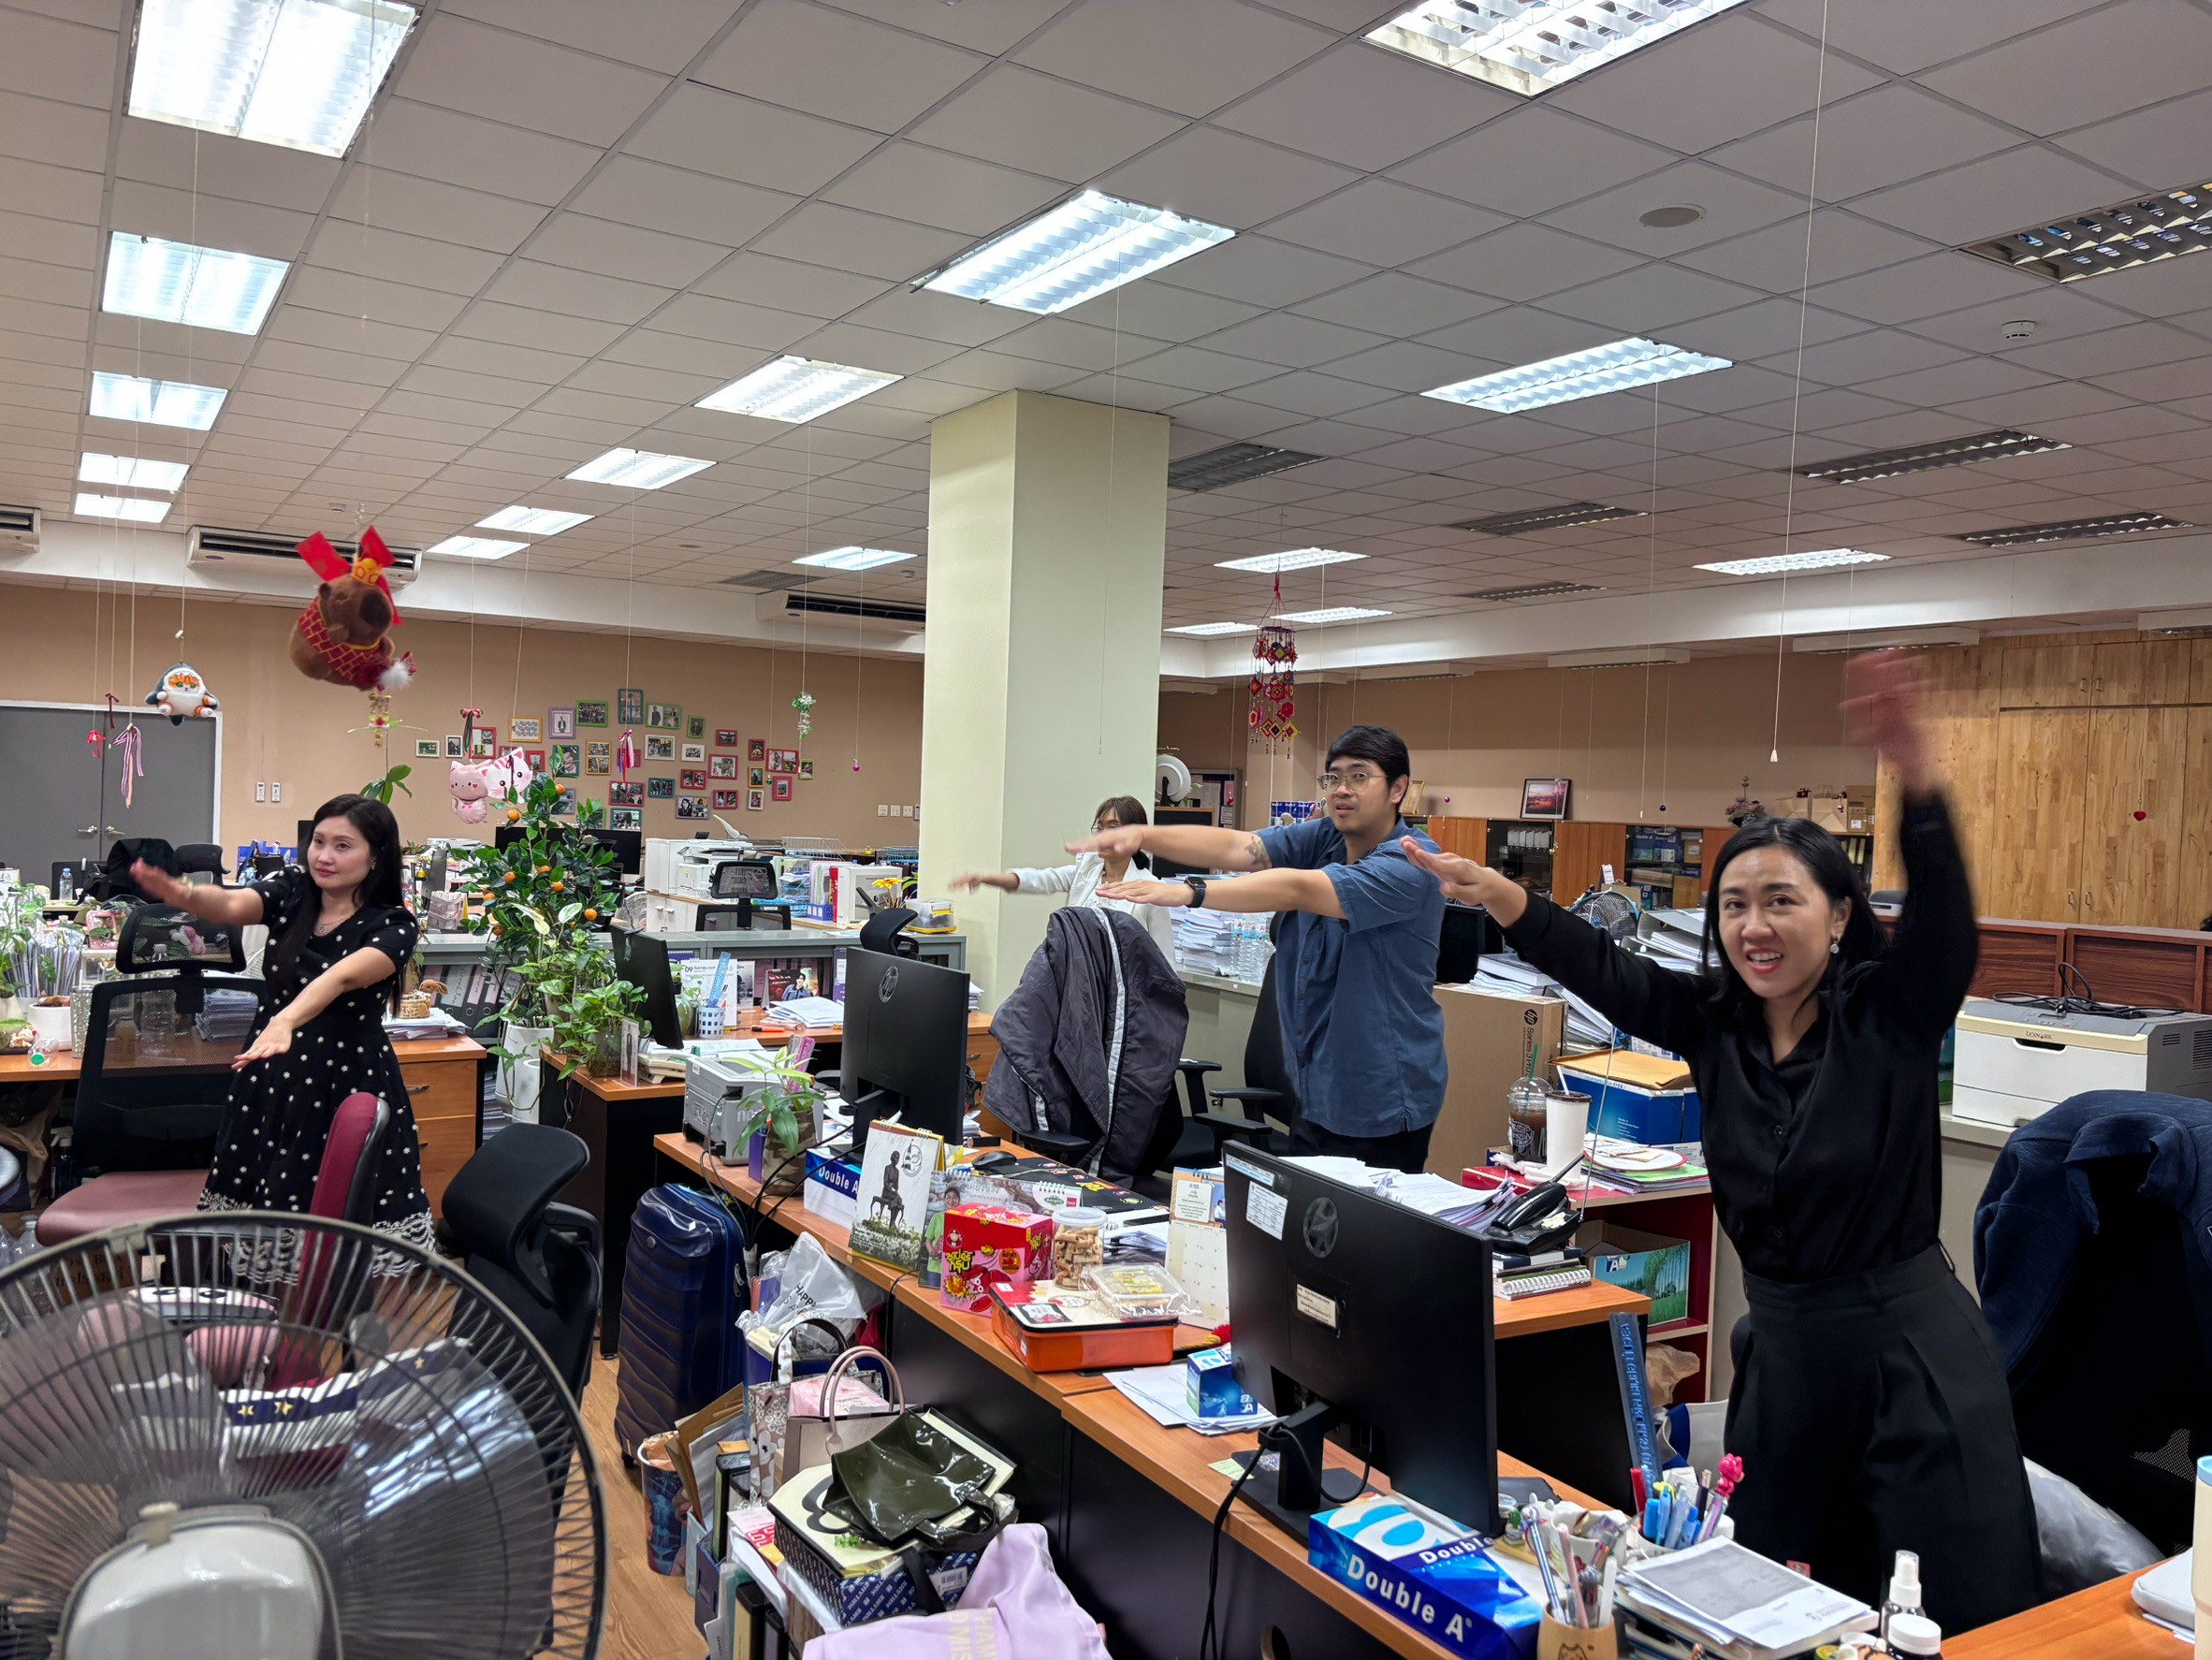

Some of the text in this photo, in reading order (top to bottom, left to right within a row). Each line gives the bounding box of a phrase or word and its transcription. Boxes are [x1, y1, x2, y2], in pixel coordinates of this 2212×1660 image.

[1524, 1009, 1537, 1026] hp
[818, 1166, 859, 1195] Double A
[1419, 1536, 1494, 1565] Double
[1347, 1553, 1465, 1644] Double A
